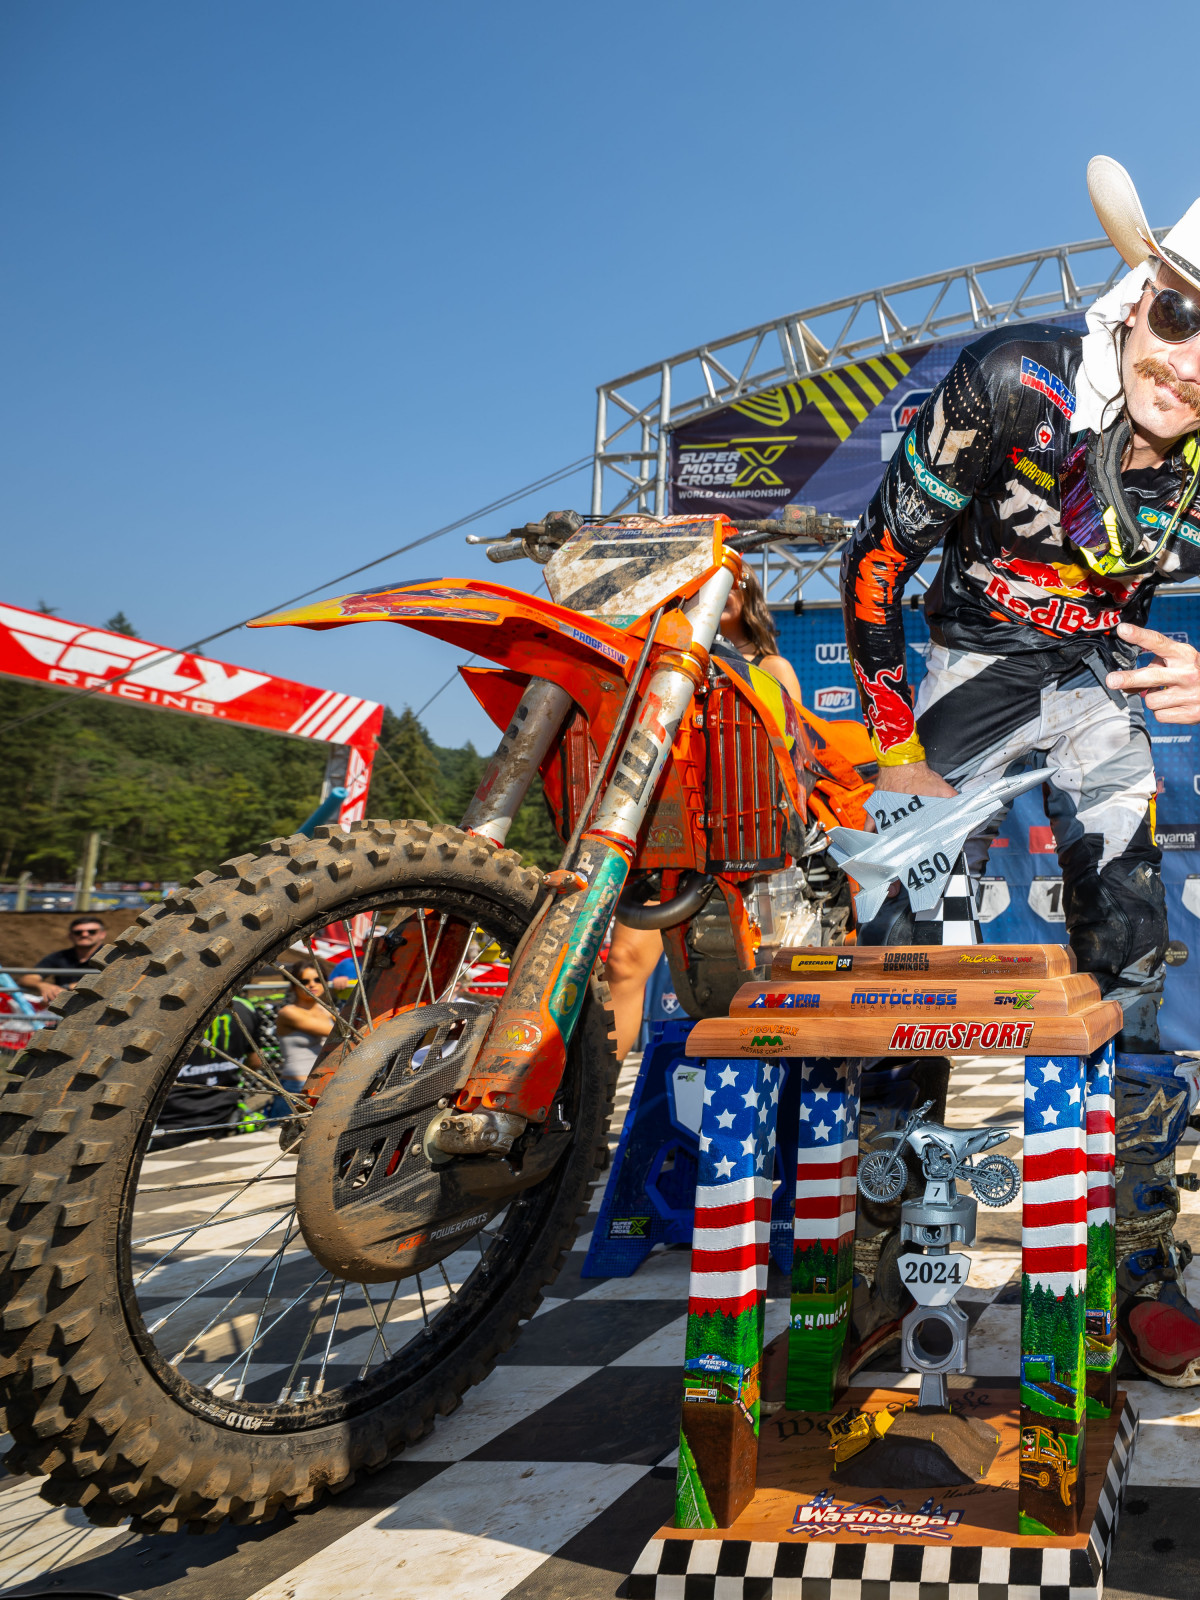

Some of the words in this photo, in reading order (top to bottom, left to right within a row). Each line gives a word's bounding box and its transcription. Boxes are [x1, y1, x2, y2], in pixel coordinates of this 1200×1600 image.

[1021, 356, 1076, 413] PARTS
[678, 452, 741, 464] SUPER
[681, 463, 738, 475] MOTO
[677, 473, 738, 486] CROSS
[678, 490, 713, 499] WORLD
[715, 488, 791, 498] CHAMPIONSHIP
[560, 541, 703, 611] 7
[984, 572, 1060, 629] Red
[1056, 602, 1121, 634] Bull
[572, 628, 626, 665] PROGRESSIVE
[820, 691, 850, 702] 100%
[875, 795, 925, 831] 2nd
[1154, 832, 1196, 845] qvarna
[724, 861, 742, 870] Twin
[907, 851, 951, 892] 450
[530, 852, 595, 978] DUNLP
[838, 958, 851, 967] CAT
[748, 994, 794, 1008] AMA
[795, 994, 820, 1002] PRO
[851, 993, 957, 1005] MOTOCROSS
[994, 993, 1036, 1009] SMX
[933, 1187, 941, 1198] 7
[430, 1212, 488, 1242] POWERPARTS
[904, 1261, 962, 1285] 2024
[799, 1505, 961, 1527] Washougal
